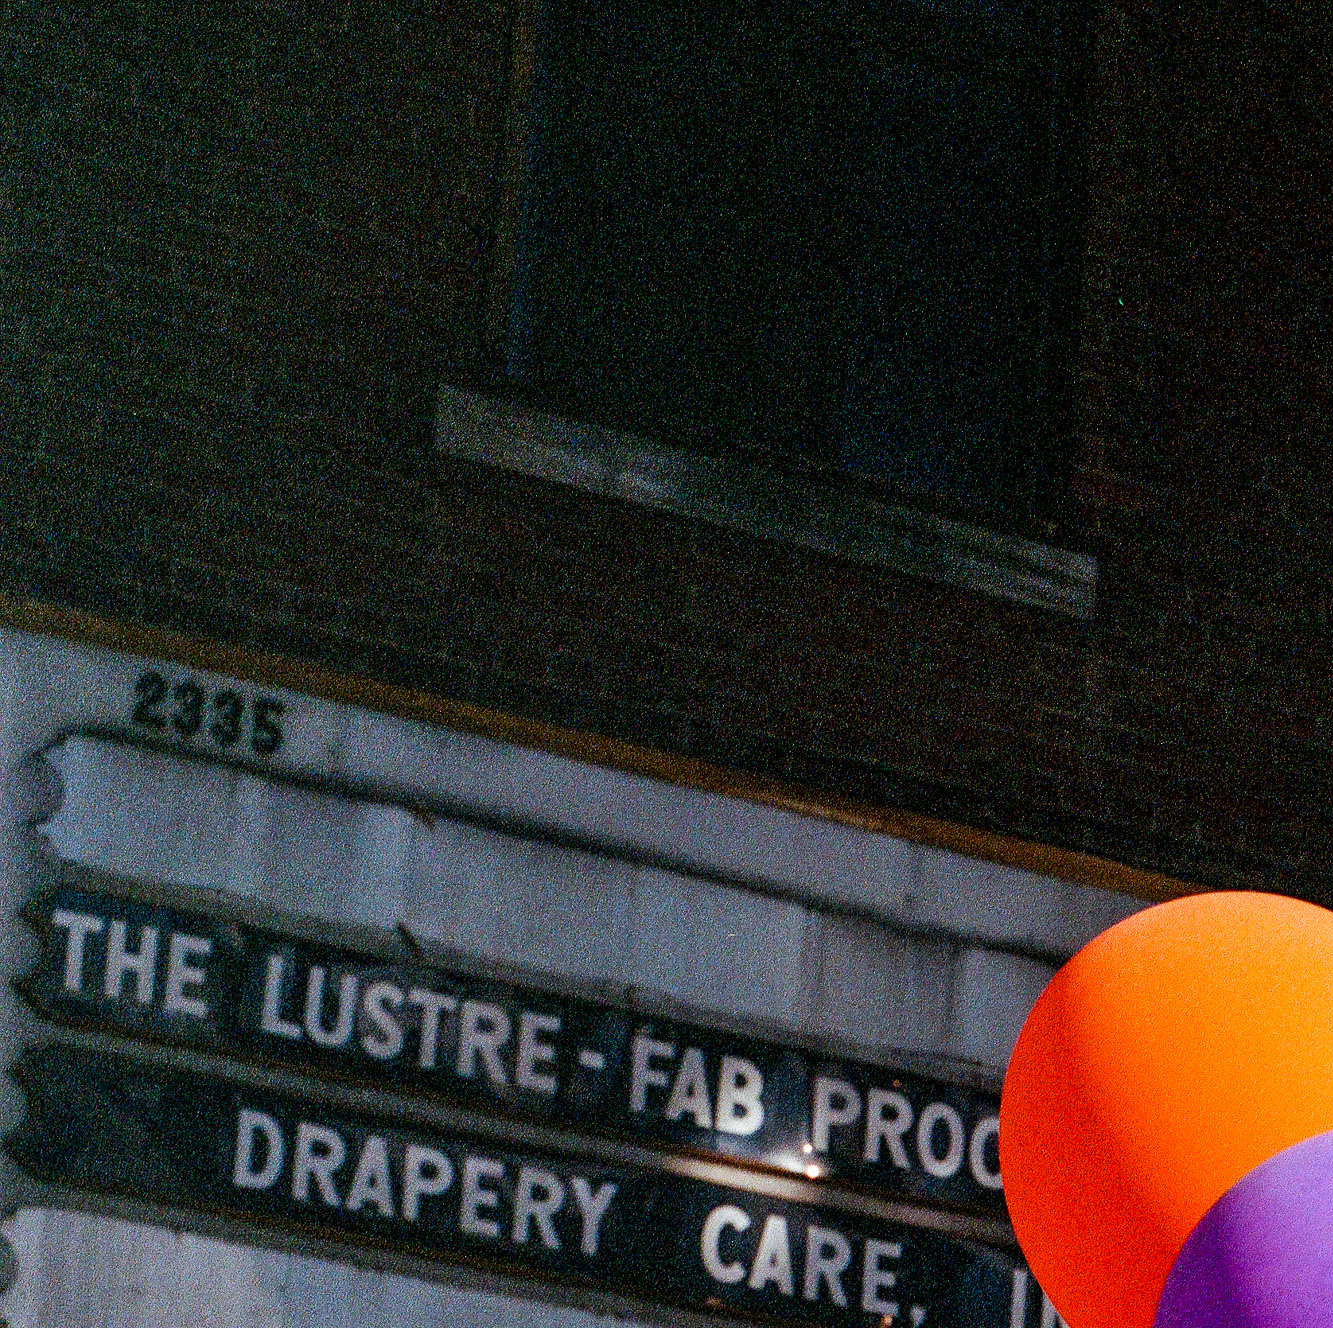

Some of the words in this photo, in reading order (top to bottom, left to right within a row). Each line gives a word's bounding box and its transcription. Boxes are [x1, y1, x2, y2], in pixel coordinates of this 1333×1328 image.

[133, 671, 285, 753] 2335
[52, 907, 212, 1017] THE
[232, 1108, 617, 1258] DRAPERY
